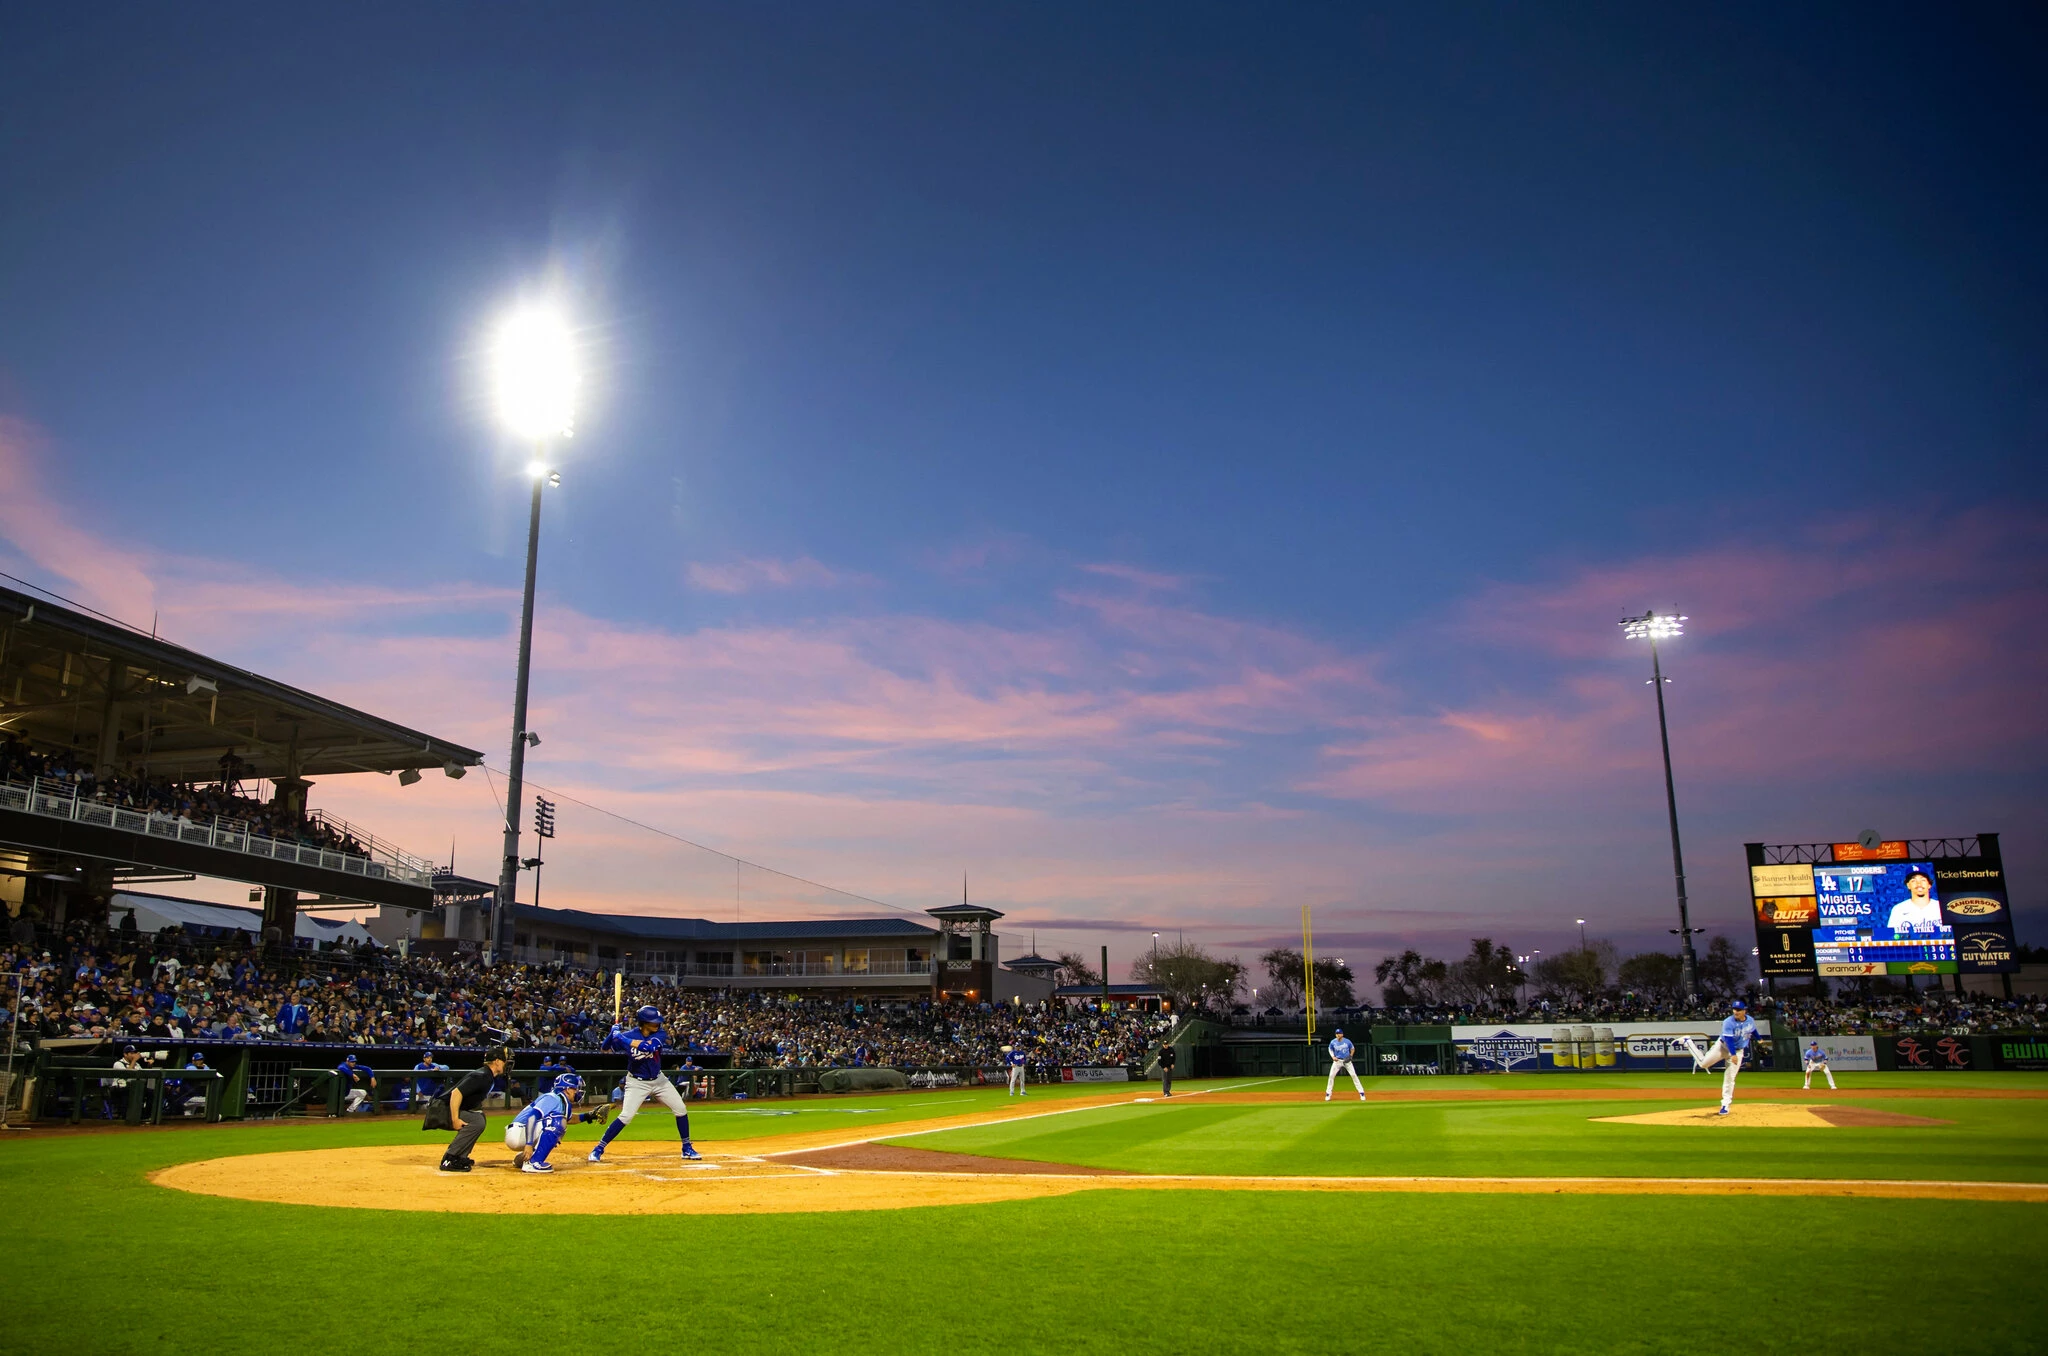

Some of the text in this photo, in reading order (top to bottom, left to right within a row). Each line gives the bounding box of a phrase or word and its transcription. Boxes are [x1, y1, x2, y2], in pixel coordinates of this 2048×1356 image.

[1936, 869, 1999, 879] TicketSmarter
[1820, 871, 1837, 891] LA
[1846, 876, 1863, 892] 17
[1820, 894, 1861, 904] MIGUEL
[1820, 904, 1872, 915] VARGAS
[1950, 899, 1997, 910] SANDERSON
[1962, 905, 1985, 914] Ford
[1962, 952, 2010, 961] CUTWATER
[1826, 964, 1863, 973] aramark
[1951, 1027, 1969, 1035] 379
